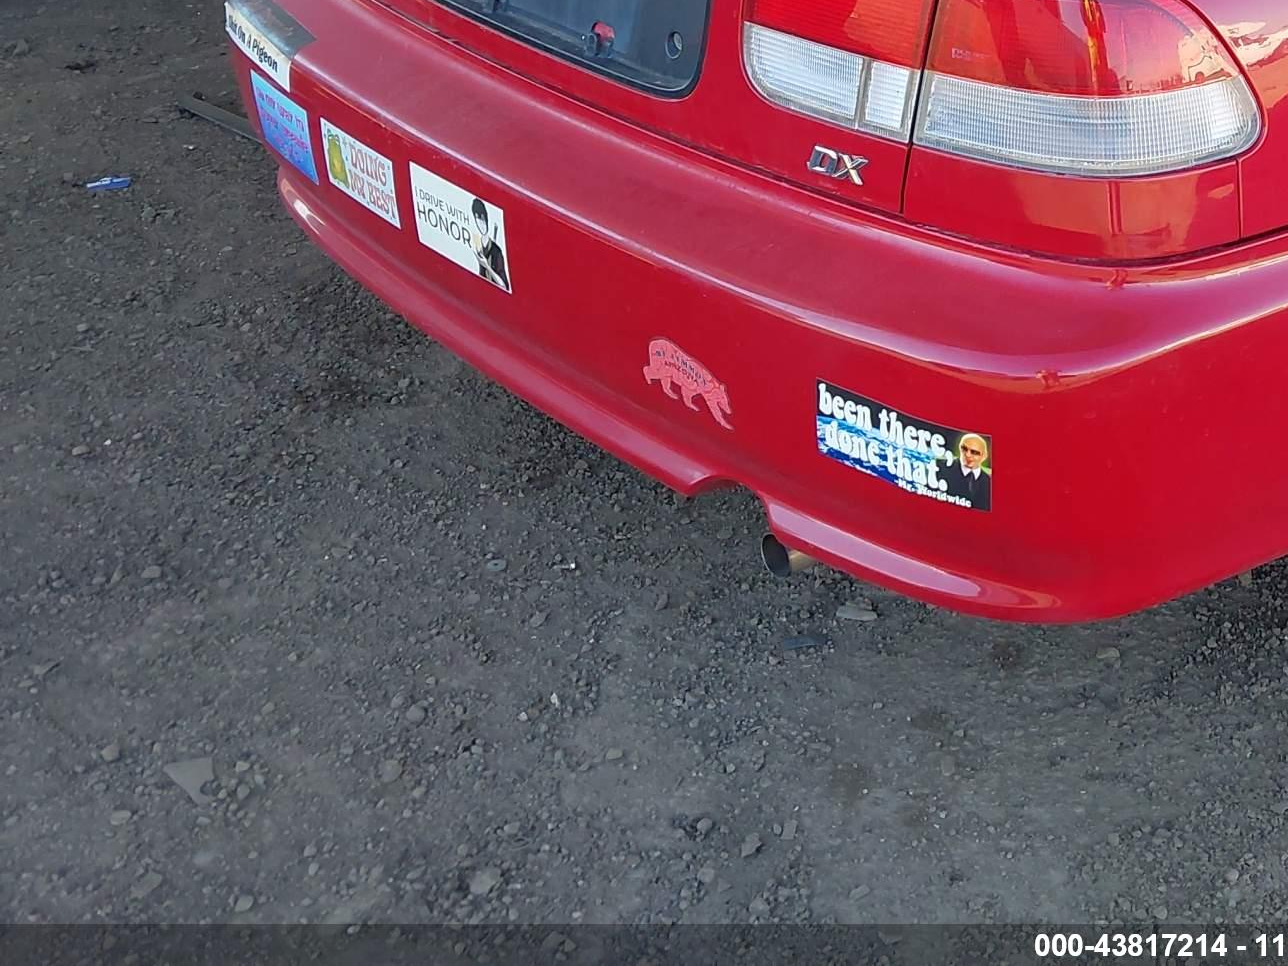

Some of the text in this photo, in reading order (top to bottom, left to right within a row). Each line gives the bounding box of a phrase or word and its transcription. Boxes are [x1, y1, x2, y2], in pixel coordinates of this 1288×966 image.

[252, 38, 278, 73] Pigeon
[349, 142, 387, 187] DOING
[806, 145, 869, 185] DX
[349, 169, 396, 220] MY BEST
[420, 188, 445, 212] DRIVE
[445, 201, 470, 226] WITH
[417, 201, 472, 249] HONOR
[818, 382, 954, 467] been there,
[825, 420, 949, 492] done that.
[916, 484, 973, 509] Worldwide
